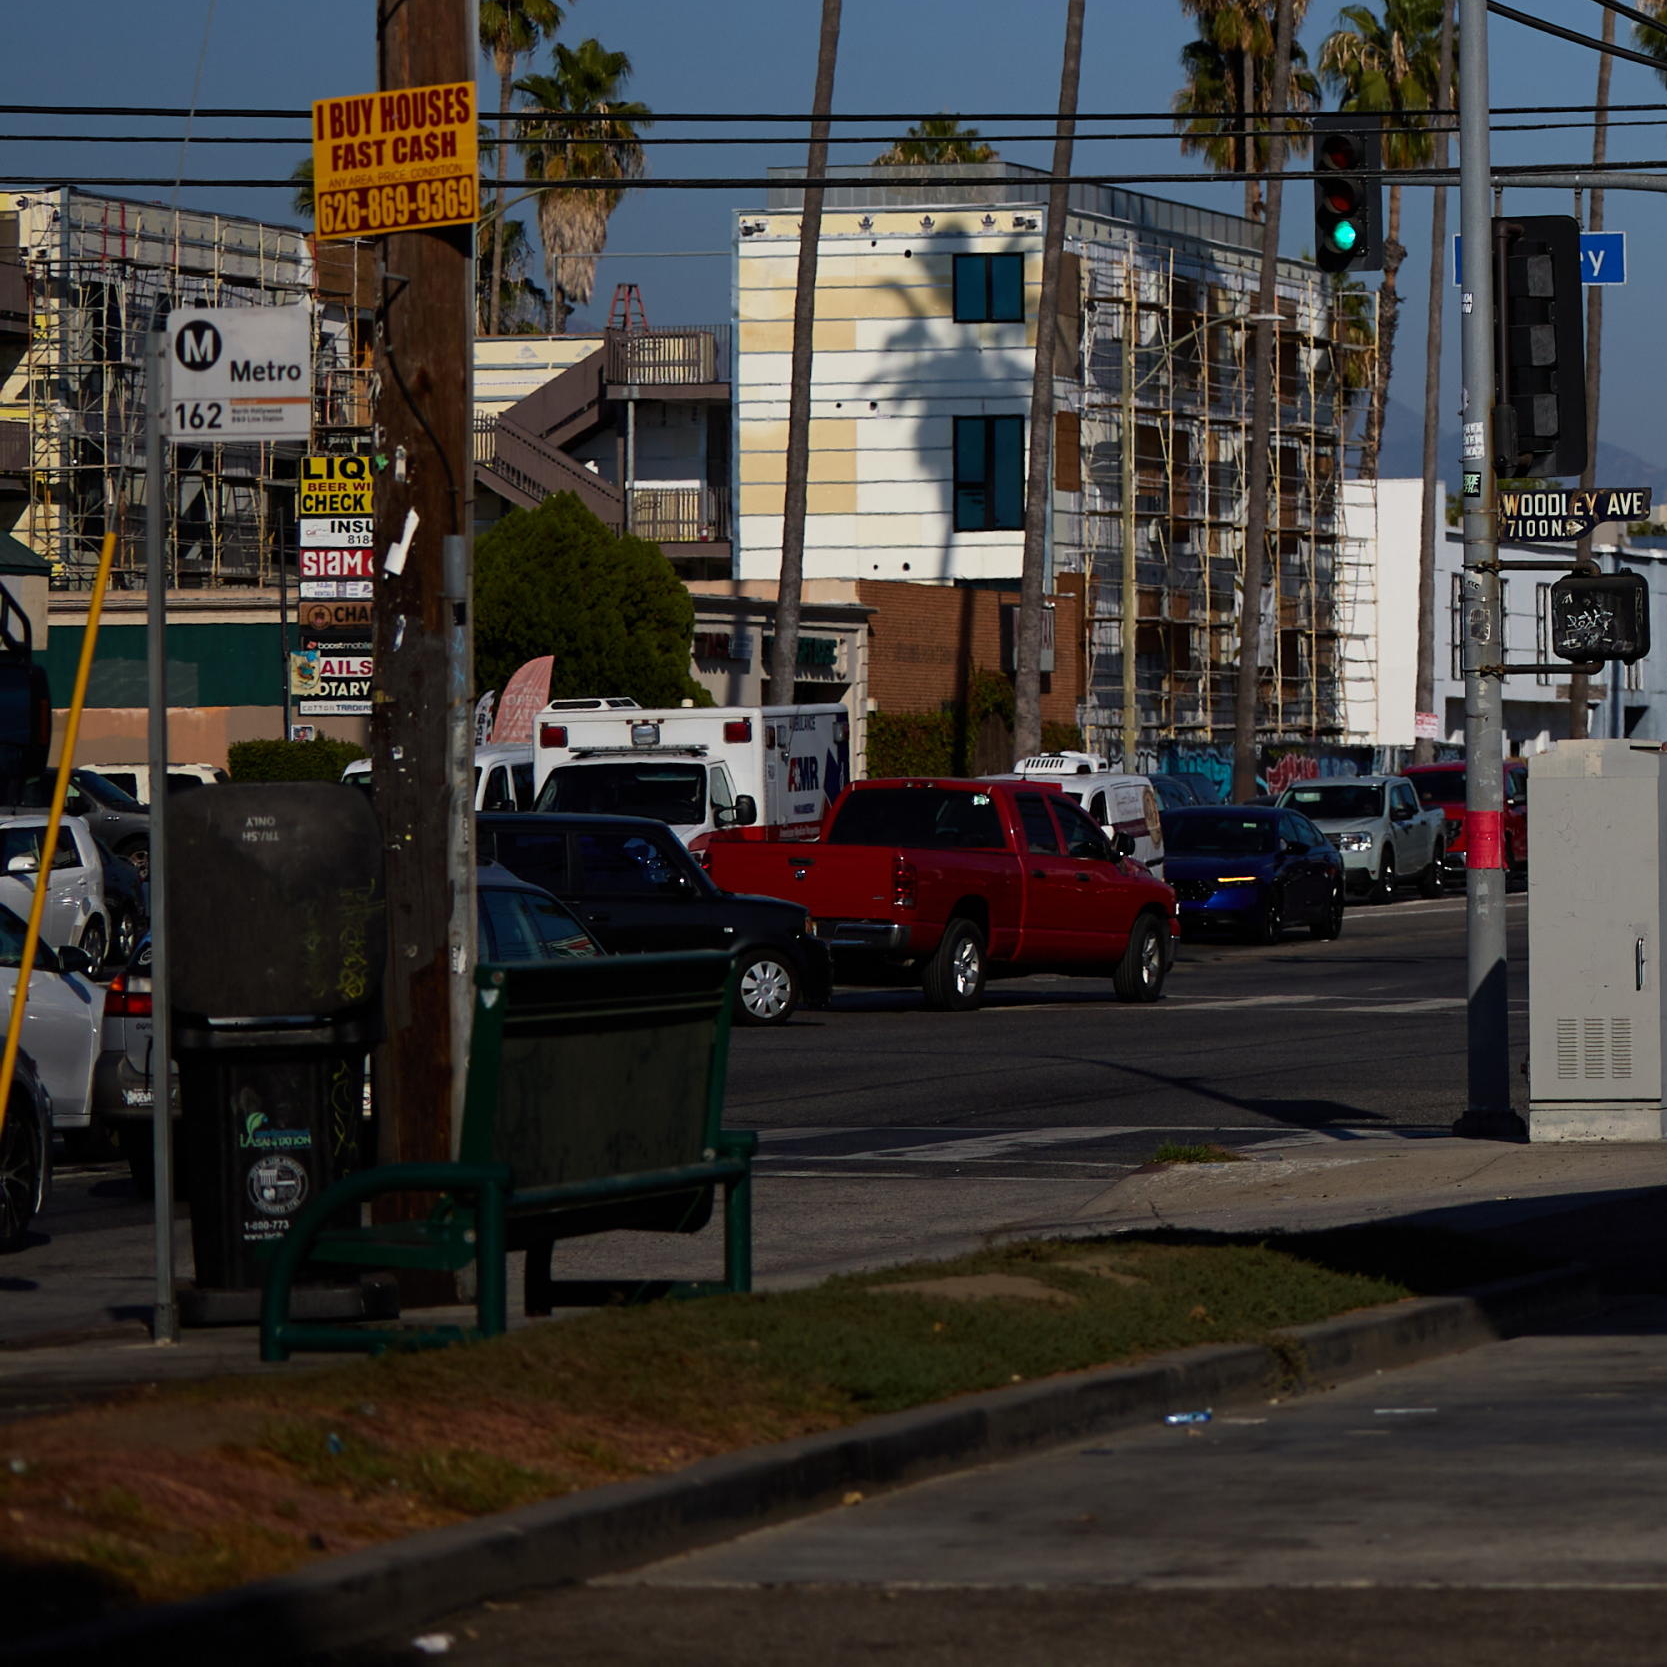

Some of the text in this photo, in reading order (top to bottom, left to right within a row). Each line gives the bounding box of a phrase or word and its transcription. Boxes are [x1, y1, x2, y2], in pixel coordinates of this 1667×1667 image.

[317, 87, 469, 140] I BUY HOUSES
[332, 131, 456, 171] FAST CA$H
[320, 176, 473, 234] 626-869-9369
[230, 360, 301, 382] Metro
[175, 403, 222, 430] 162
[303, 457, 373, 481] LIQ
[307, 482, 347, 492] BEER
[303, 494, 365, 512] CHECK
[788, 756, 819, 792] AMR
[246, 817, 276, 827] ONLY
